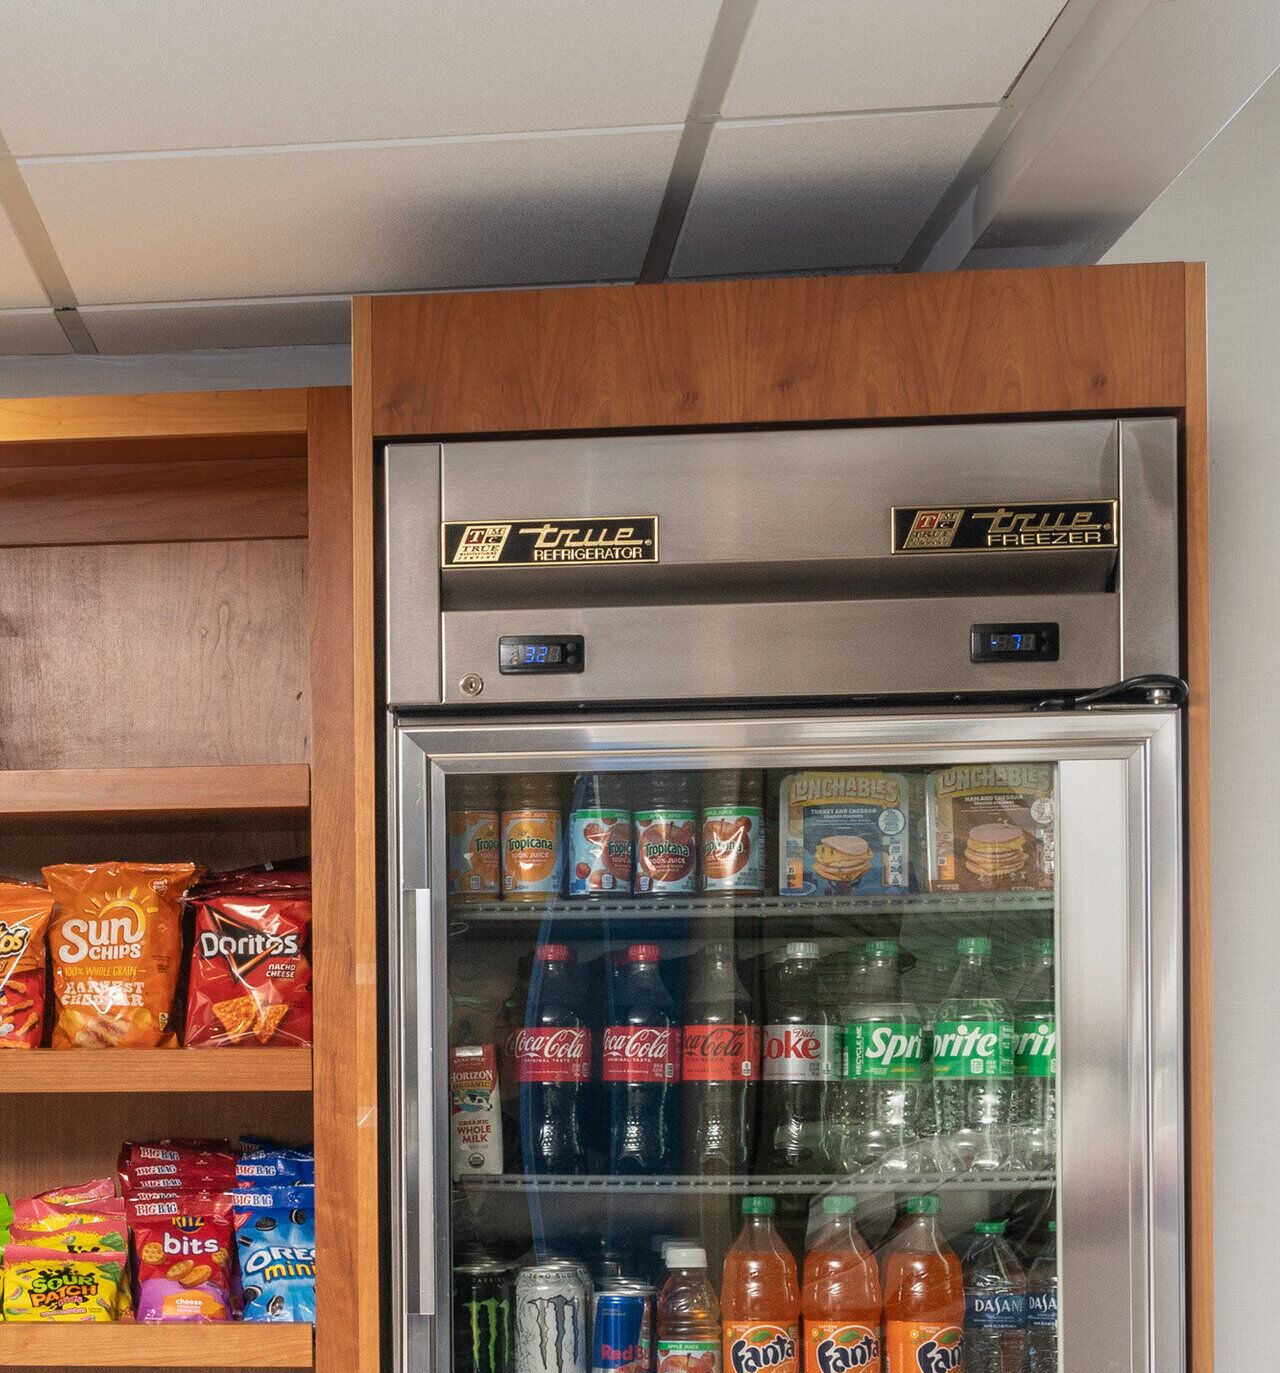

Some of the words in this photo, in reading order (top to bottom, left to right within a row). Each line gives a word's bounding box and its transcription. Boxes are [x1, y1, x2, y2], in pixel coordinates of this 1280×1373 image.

[986, 531, 1102, 547] FREEZER
[533, 546, 643, 561] REFRIGERATOR
[525, 646, 548, 663] 32
[791, 775, 899, 802] LUNCHABLES
[938, 766, 1054, 795] LUNCHABLES
[507, 835, 553, 851] Tropicana
[645, 841, 689, 857] Tropicana
[58, 916, 146, 963] Sun
[200, 931, 299, 959] Doritos
[88, 944, 142, 961] CHIPS
[266, 970, 296, 978] CHEESE
[515, 1028, 586, 1059] Coca-Cola
[763, 1031, 821, 1060] oke
[865, 1027, 921, 1066] Spri
[456, 1125, 491, 1134] WHOLE
[461, 1133, 488, 1143] MILK
[236, 1165, 254, 1176] BIG
[255, 1165, 276, 1176] BAG
[135, 1204, 157, 1215] BIG
[157, 1203, 178, 1214] BAG
[233, 1194, 252, 1206] BIG
[252, 1194, 273, 1207] BAG
[163, 1232, 219, 1255] bits
[32, 1274, 94, 1294] SOUR
[30, 1284, 99, 1308] PATCH
[1028, 1296, 1057, 1313] DASA
